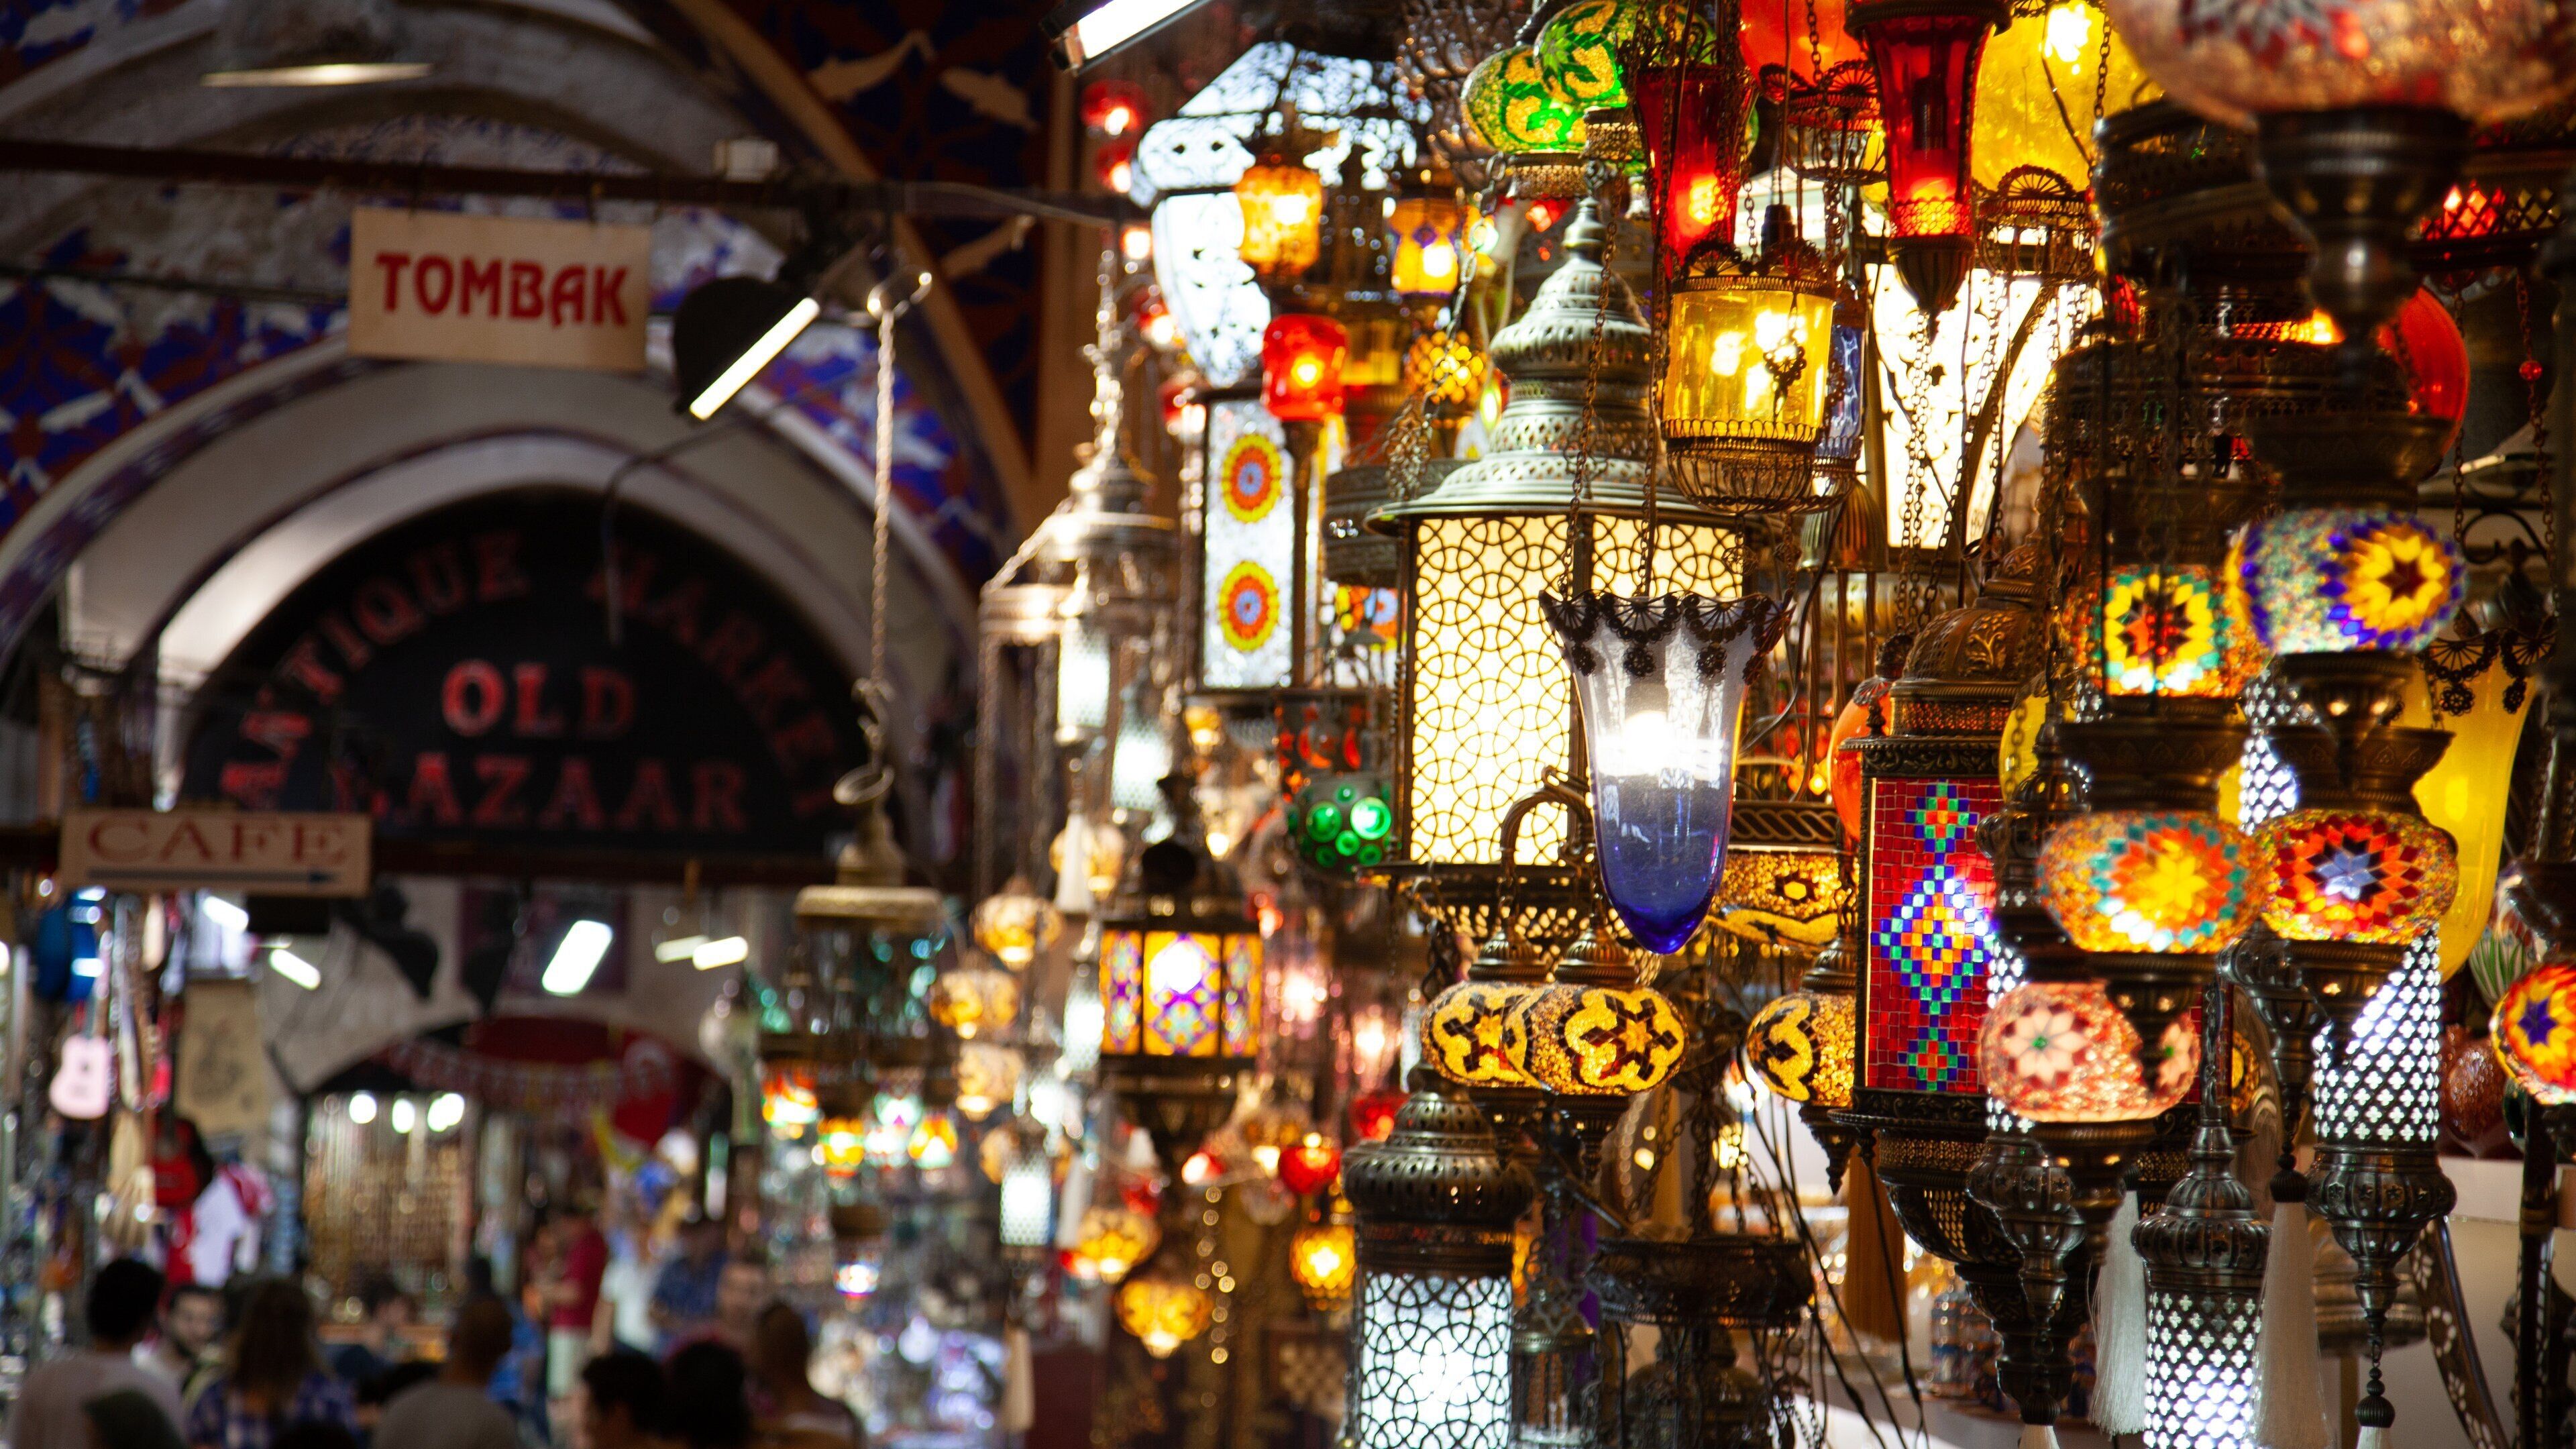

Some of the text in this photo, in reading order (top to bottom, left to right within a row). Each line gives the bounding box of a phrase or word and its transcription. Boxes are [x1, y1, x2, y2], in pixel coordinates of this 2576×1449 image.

[375, 251, 629, 327] TOMBAK
[442, 658, 637, 740] OLD
[89, 816, 345, 865] CAFE
